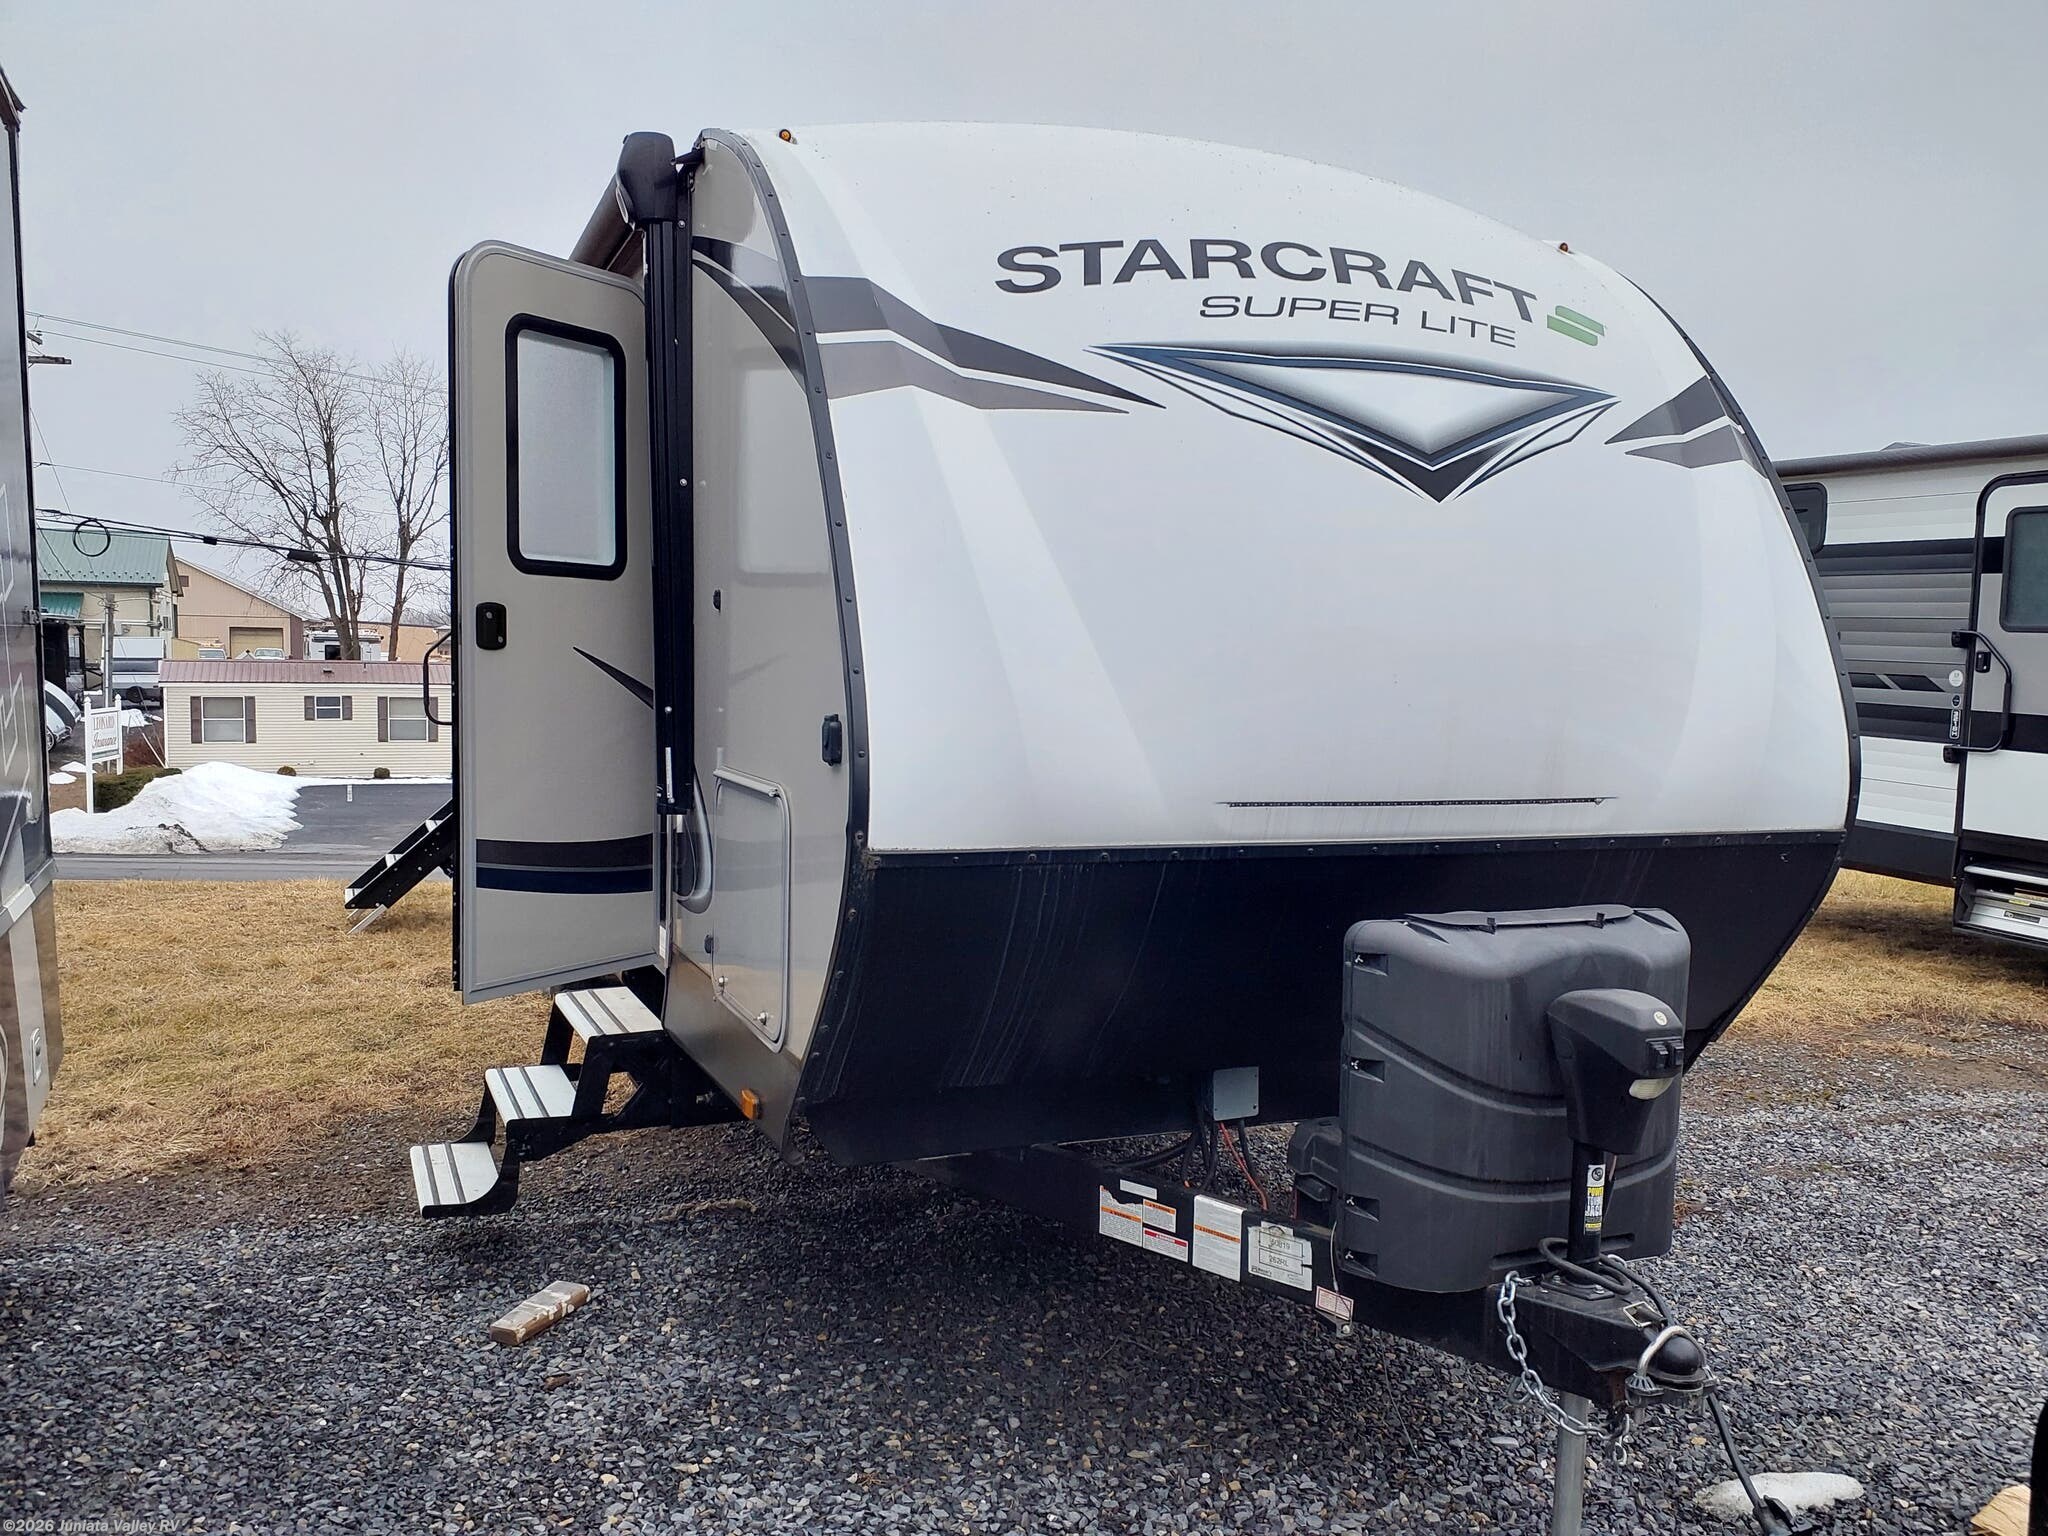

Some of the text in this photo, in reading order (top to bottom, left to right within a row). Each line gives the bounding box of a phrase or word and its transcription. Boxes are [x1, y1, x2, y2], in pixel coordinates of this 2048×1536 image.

[995, 239, 1538, 322] STARCRAFT
[1200, 296, 1517, 348] SUPER LITE
